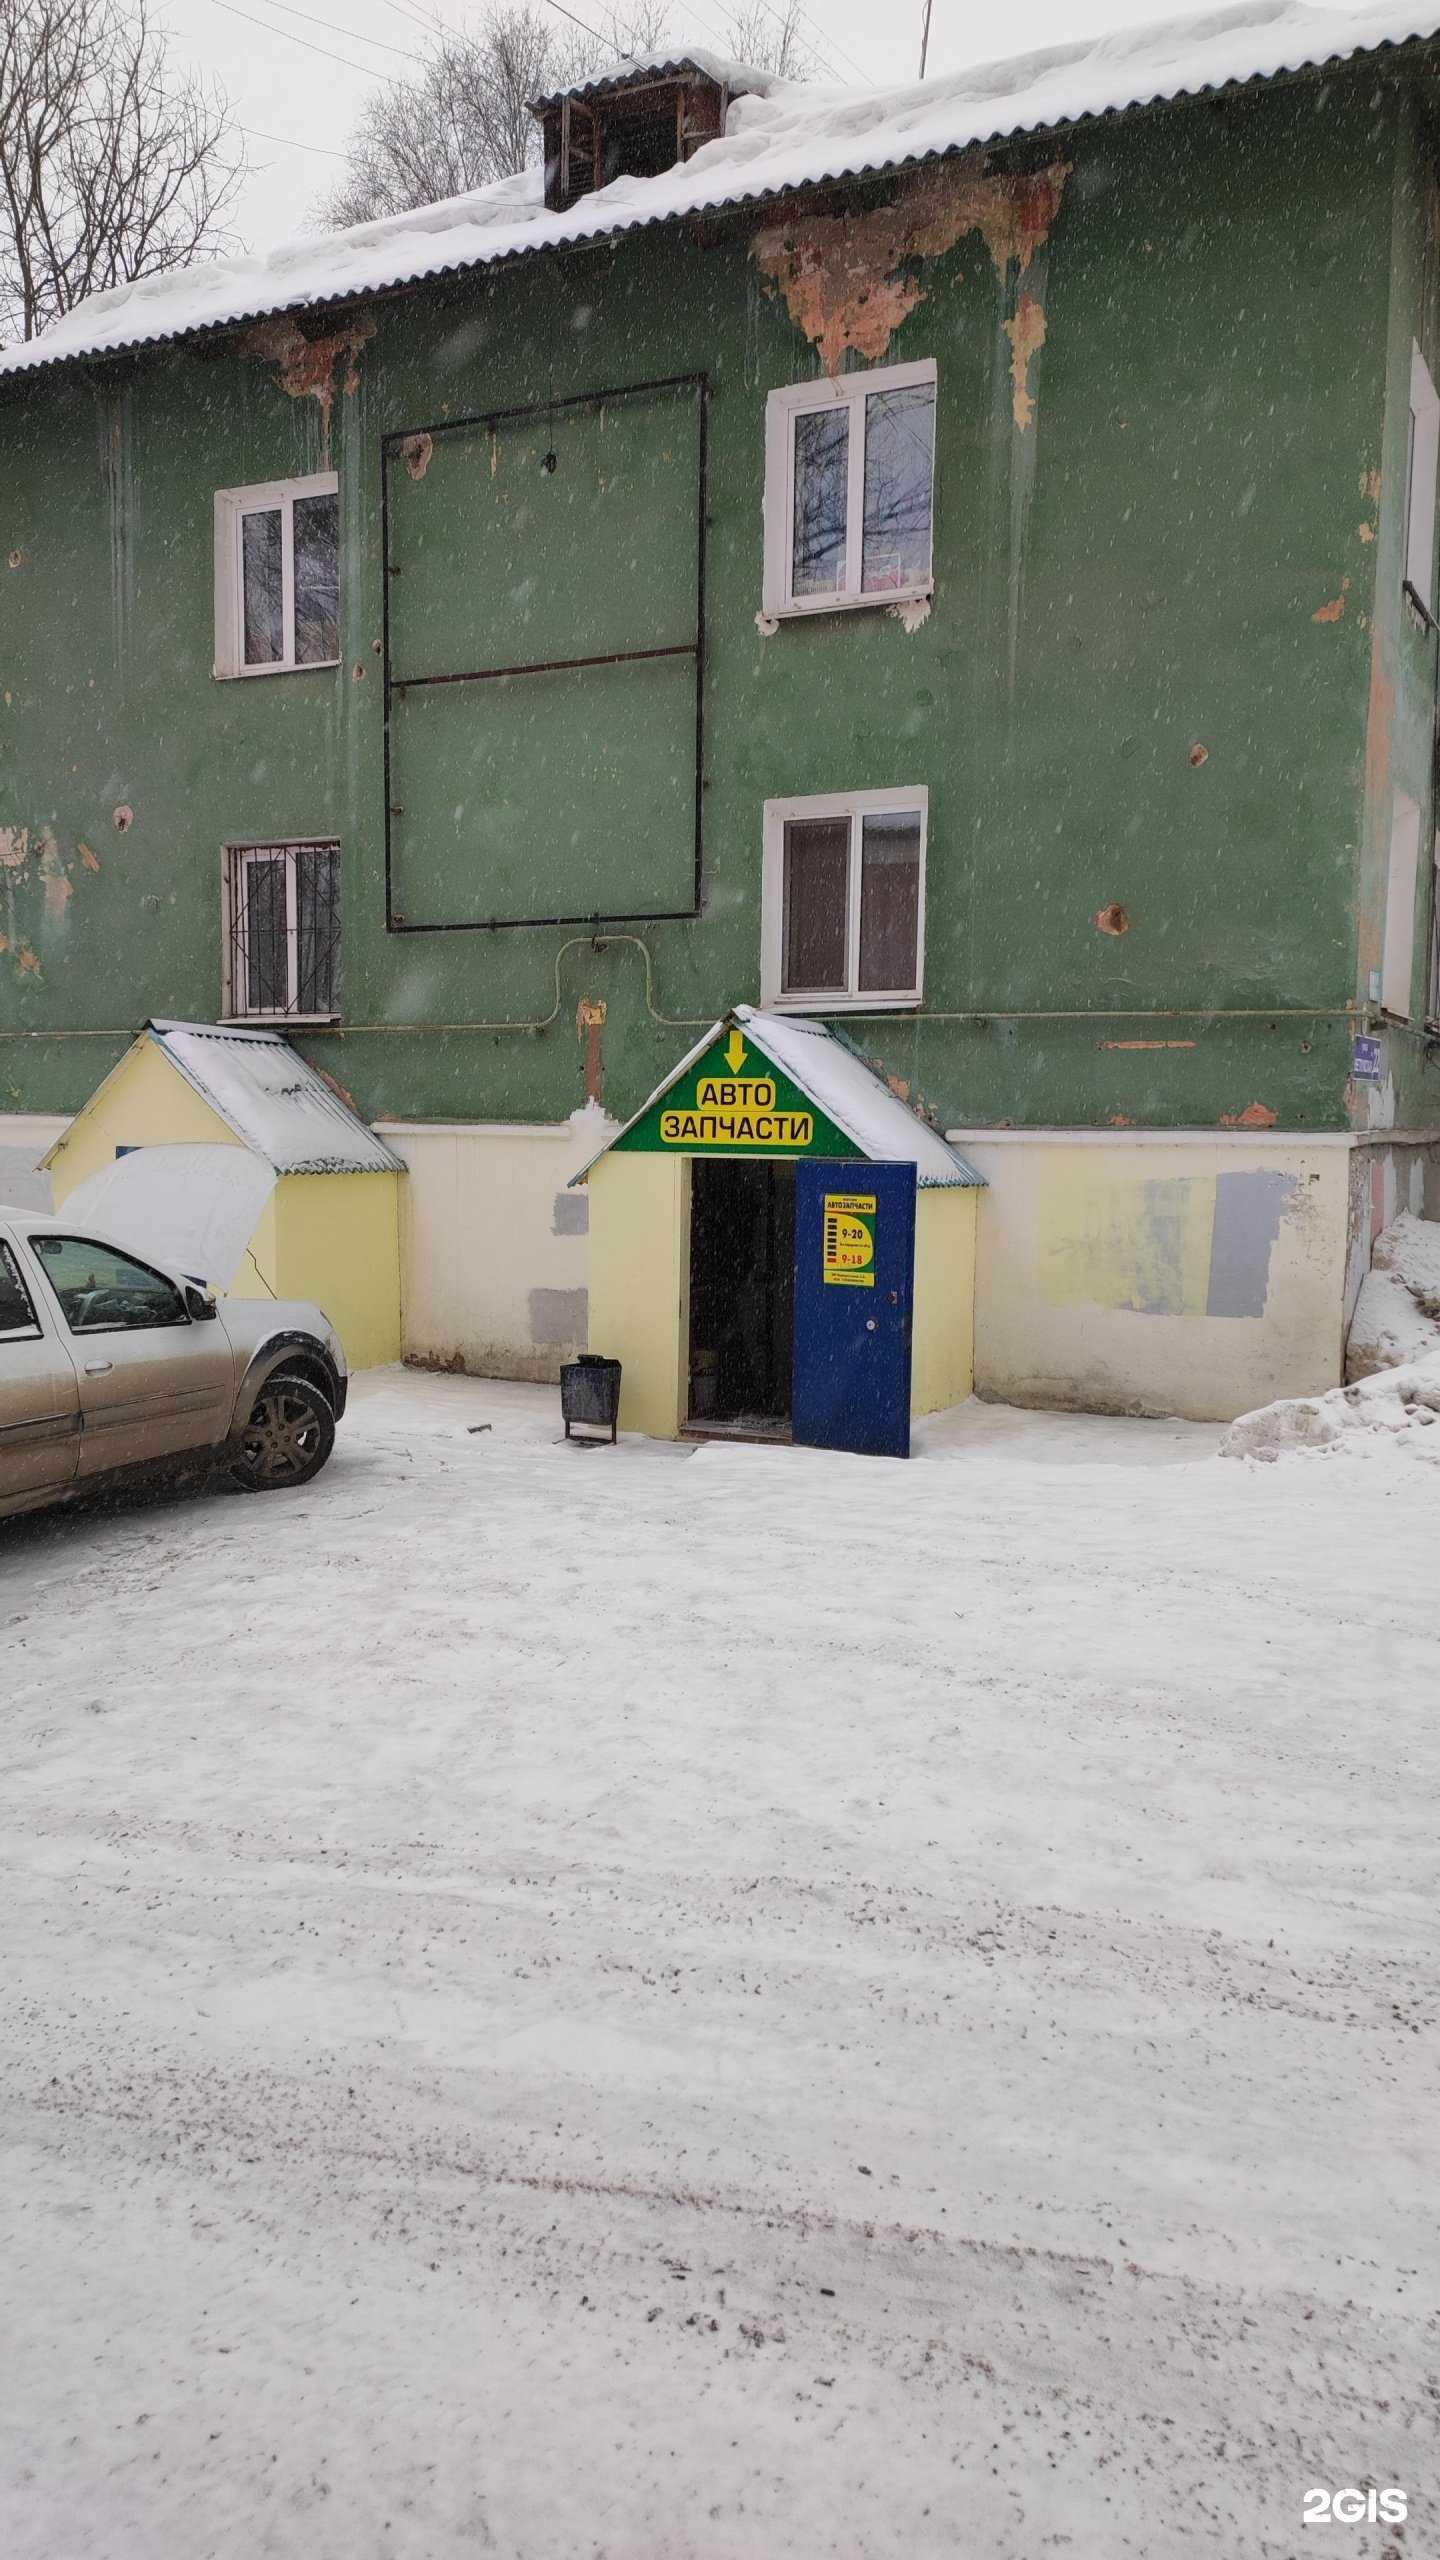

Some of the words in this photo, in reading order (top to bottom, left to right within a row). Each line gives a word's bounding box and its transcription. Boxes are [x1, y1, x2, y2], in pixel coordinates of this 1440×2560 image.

[701, 1083, 771, 1106] АВТО
[664, 1115, 809, 1140] ЗАПЧАСТИ
[827, 1201, 873, 1210] АВТОЗАПЧАСТИ
[841, 1228, 863, 1239] 9-20
[841, 1254, 863, 1265] 9-18
